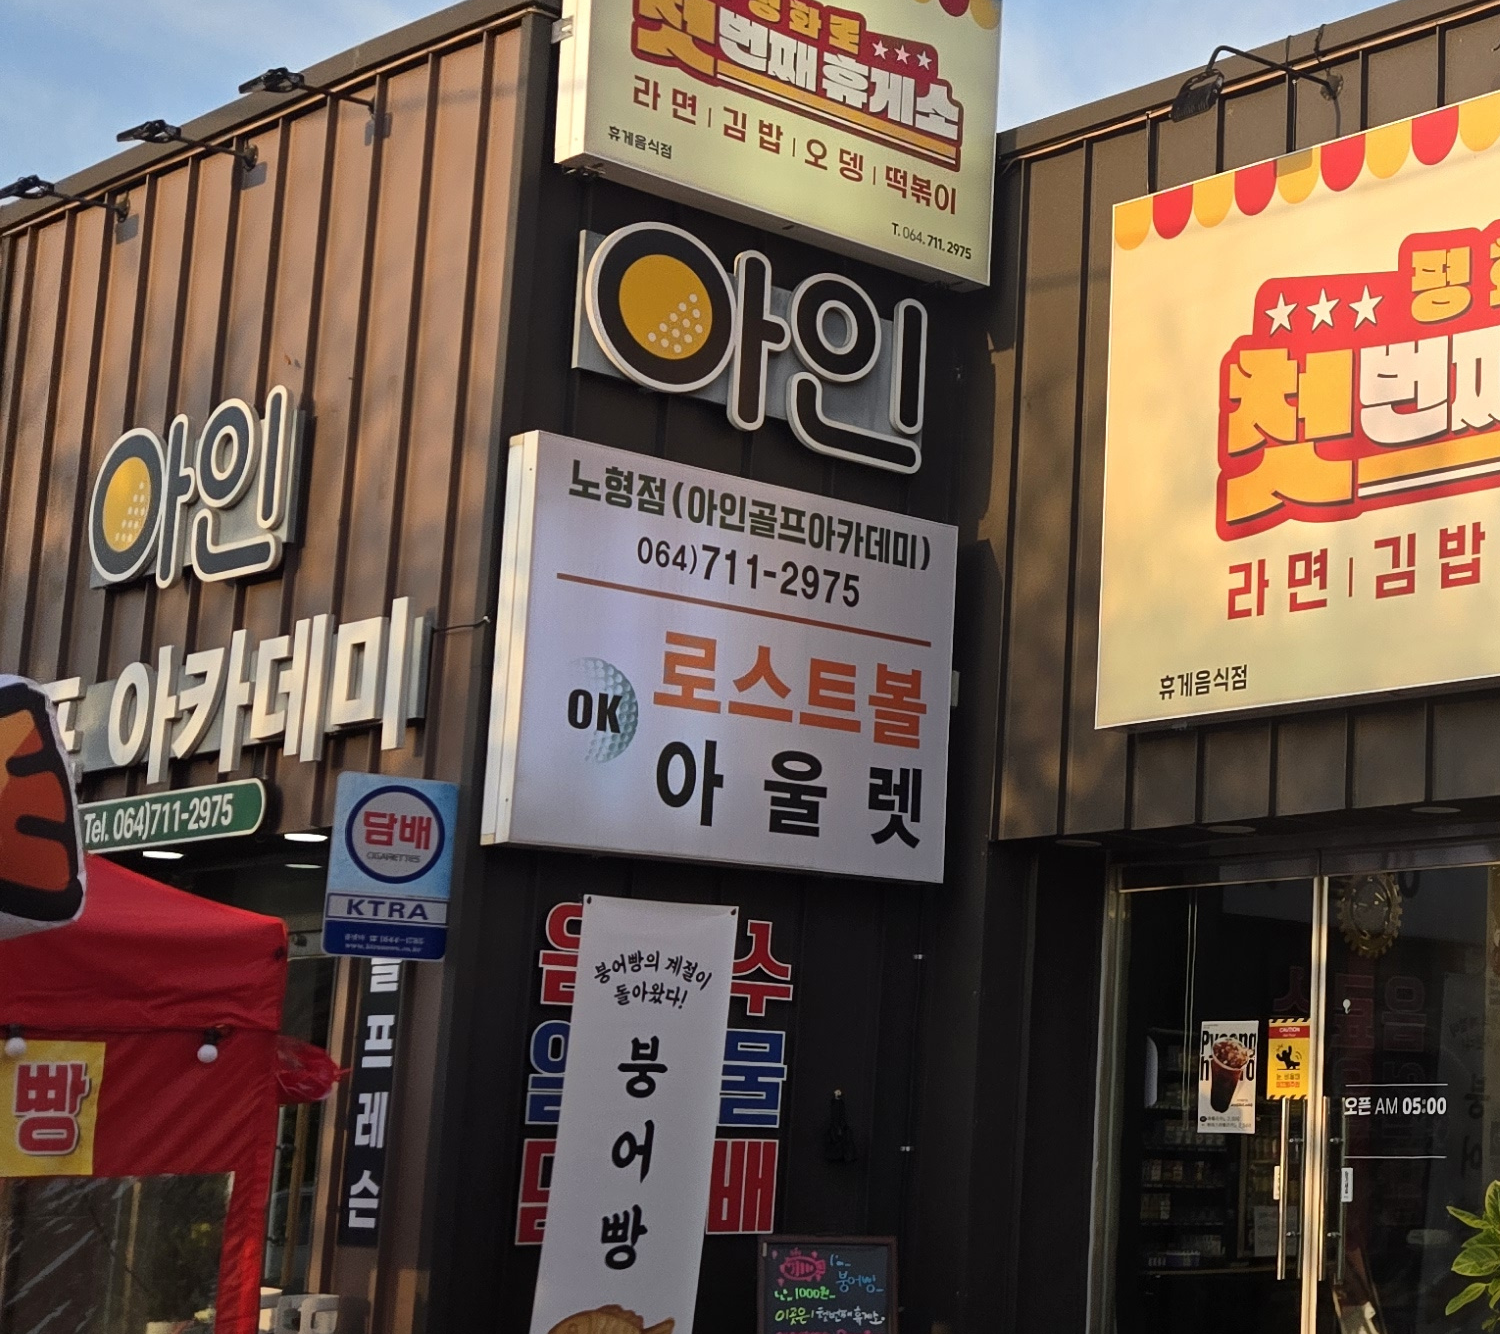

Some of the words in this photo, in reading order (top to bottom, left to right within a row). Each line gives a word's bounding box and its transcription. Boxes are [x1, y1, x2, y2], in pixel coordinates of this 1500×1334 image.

[608, 125, 673, 160] 휴게음식점
[632, 75, 697, 125] 라면
[722, 106, 784, 155] 김밥
[805, 138, 865, 184] 오뎅
[885, 165, 957, 216] 떡볶이
[586, 221, 928, 475] 아인
[88, 384, 293, 590] 아인
[1227, 547, 1329, 621] 라면
[1374, 521, 1486, 600] 김밥
[108, 596, 412, 784] 아카데미
[653, 630, 928, 750] 로스트볼
[1158, 664, 1249, 700] 휴게음식점
[566, 688, 623, 734] OK
[84, 811, 109, 844] Tel.
[113, 793, 234, 841] 064)711-2975
[655, 739, 923, 850] 아울렛
[363, 810, 432, 850] 담배
[346, 898, 429, 921] KTRA
[594, 950, 660, 984] 붕어빵의
[665, 955, 712, 991] 계절이
[614, 981, 689, 1009] 돌아왔다!
[1344, 1097, 1371, 1116] 오픈
[1375, 1097, 1398, 1115] AM
[1402, 1097, 1447, 1115] 05:00
[601, 1035, 668, 1270] 붕어빵
